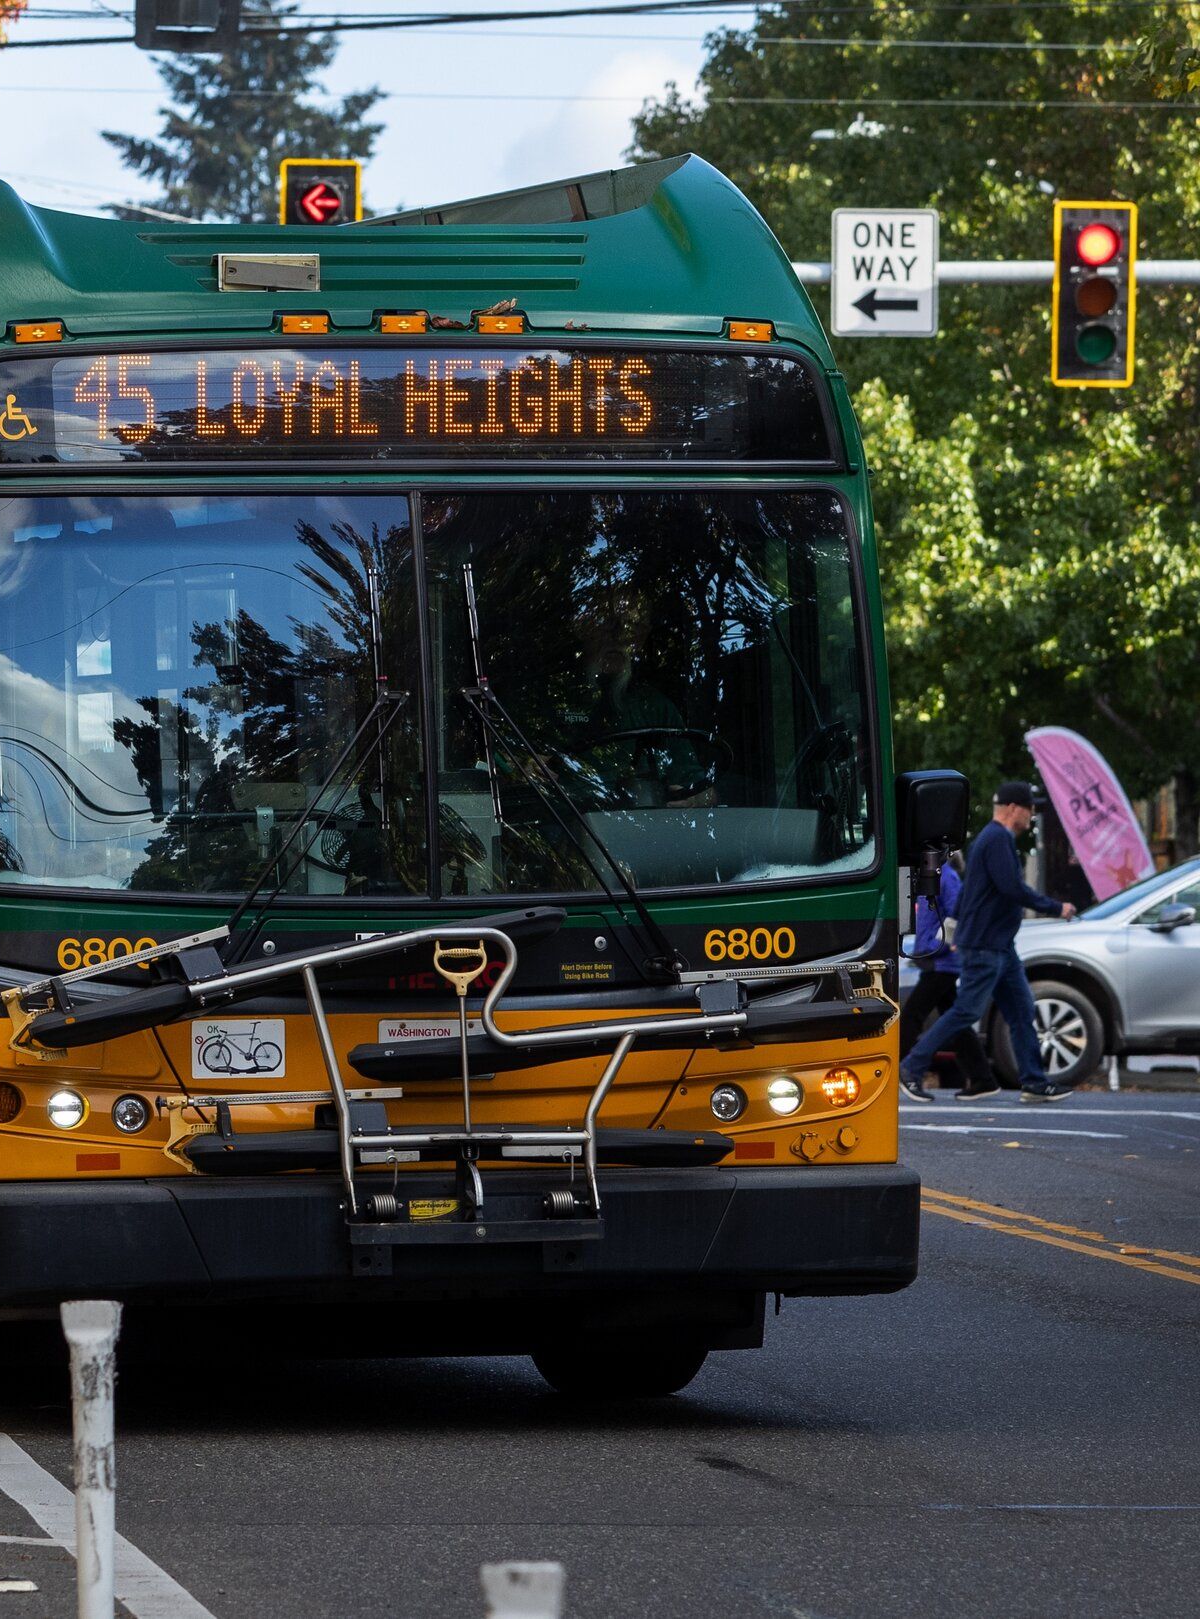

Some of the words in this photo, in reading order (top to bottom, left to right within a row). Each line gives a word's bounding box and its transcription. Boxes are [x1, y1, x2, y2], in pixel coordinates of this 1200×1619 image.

[853, 222, 915, 248] ONE
[852, 256, 917, 281] WAY
[73, 355, 155, 439] 45
[197, 360, 379, 435] LOYAL
[404, 359, 652, 434] HEIGHTS
[1070, 783, 1104, 821] PET
[704, 927, 796, 961] 6800
[207, 1025, 219, 1034] OK
[388, 1028, 451, 1037] WASHINGTON
